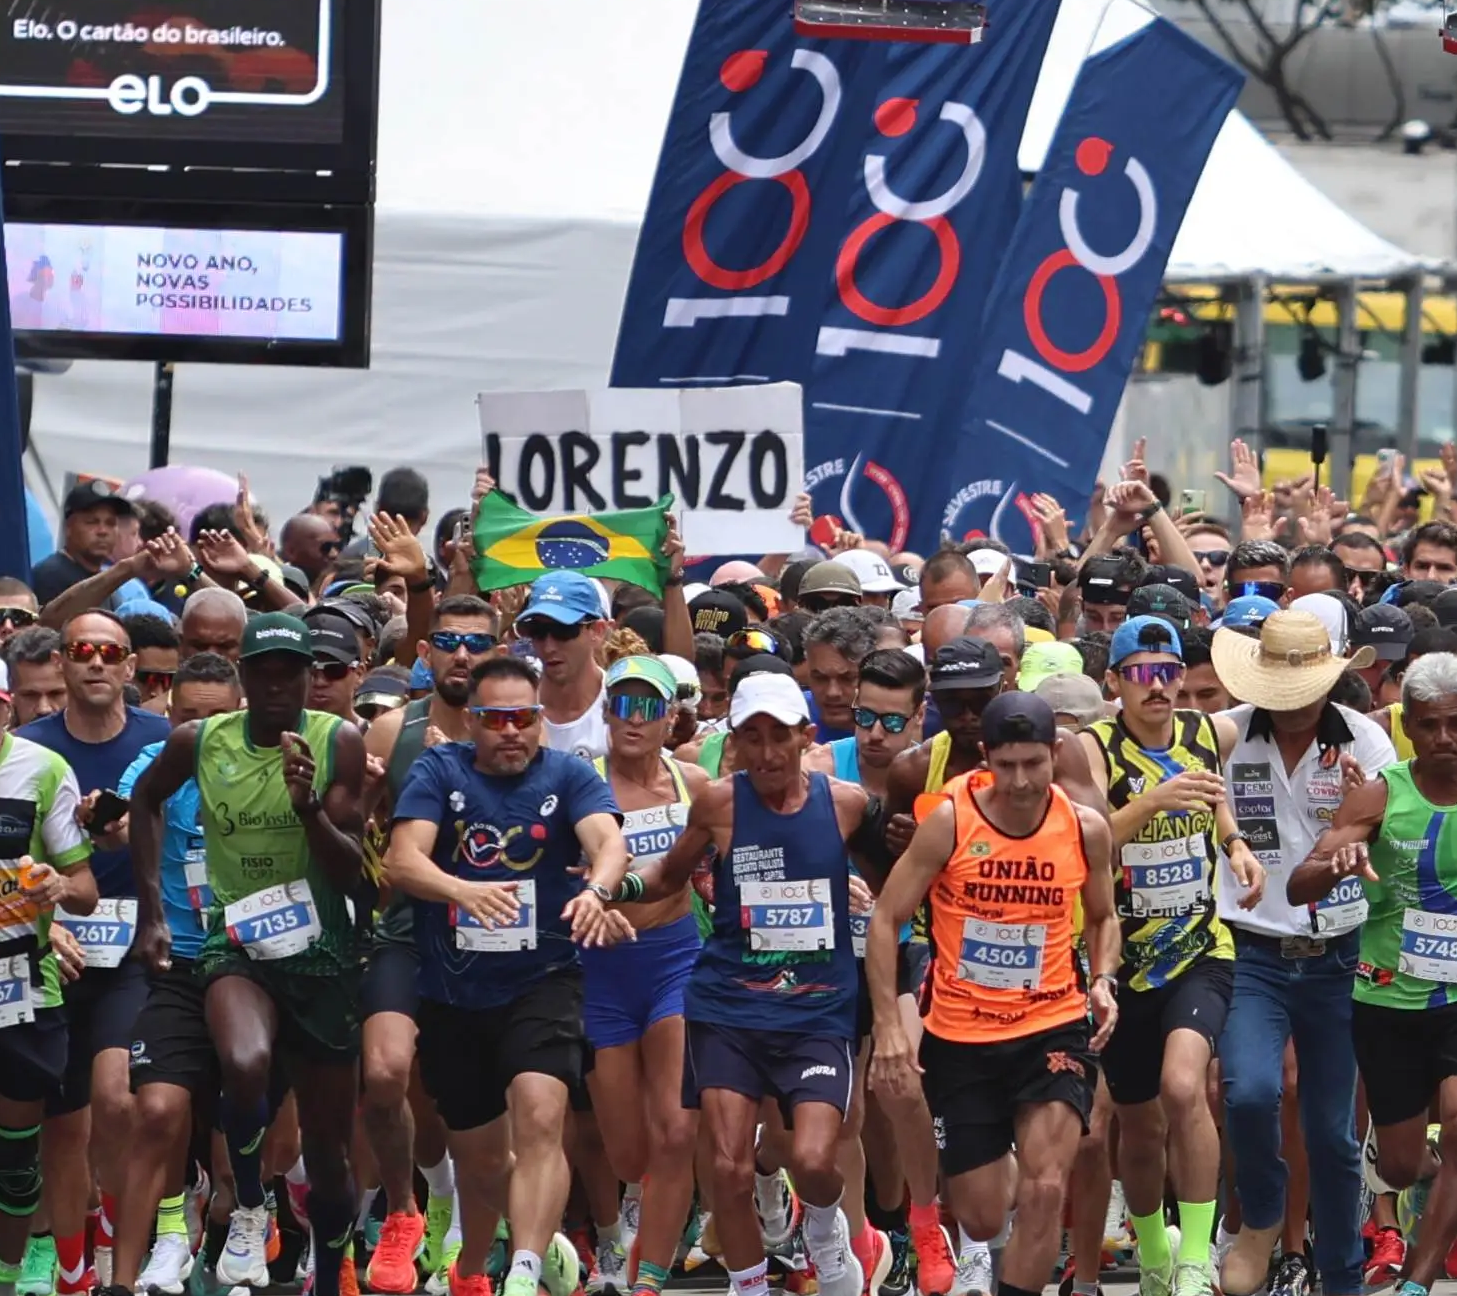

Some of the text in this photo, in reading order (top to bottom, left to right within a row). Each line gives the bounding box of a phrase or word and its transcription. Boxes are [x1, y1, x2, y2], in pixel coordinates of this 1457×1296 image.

[13, 19, 285, 47] Elo. O cartão do brasileiro.
[137, 253, 257, 275] NOVO ANO,
[136, 272, 209, 290] NOVAS
[135, 293, 312, 313] POSSIBILIDADES
[485, 429, 788, 512] LORENZO
[979, 856, 1055, 882] UNIÃO
[1145, 863, 1194, 886] 8528
[964, 882, 1064, 906] RUNNING
[250, 909, 298, 939] 7135
[766, 907, 815, 927] 5787
[76, 925, 119, 944] 2617
[974, 946, 1028, 967] 4506
